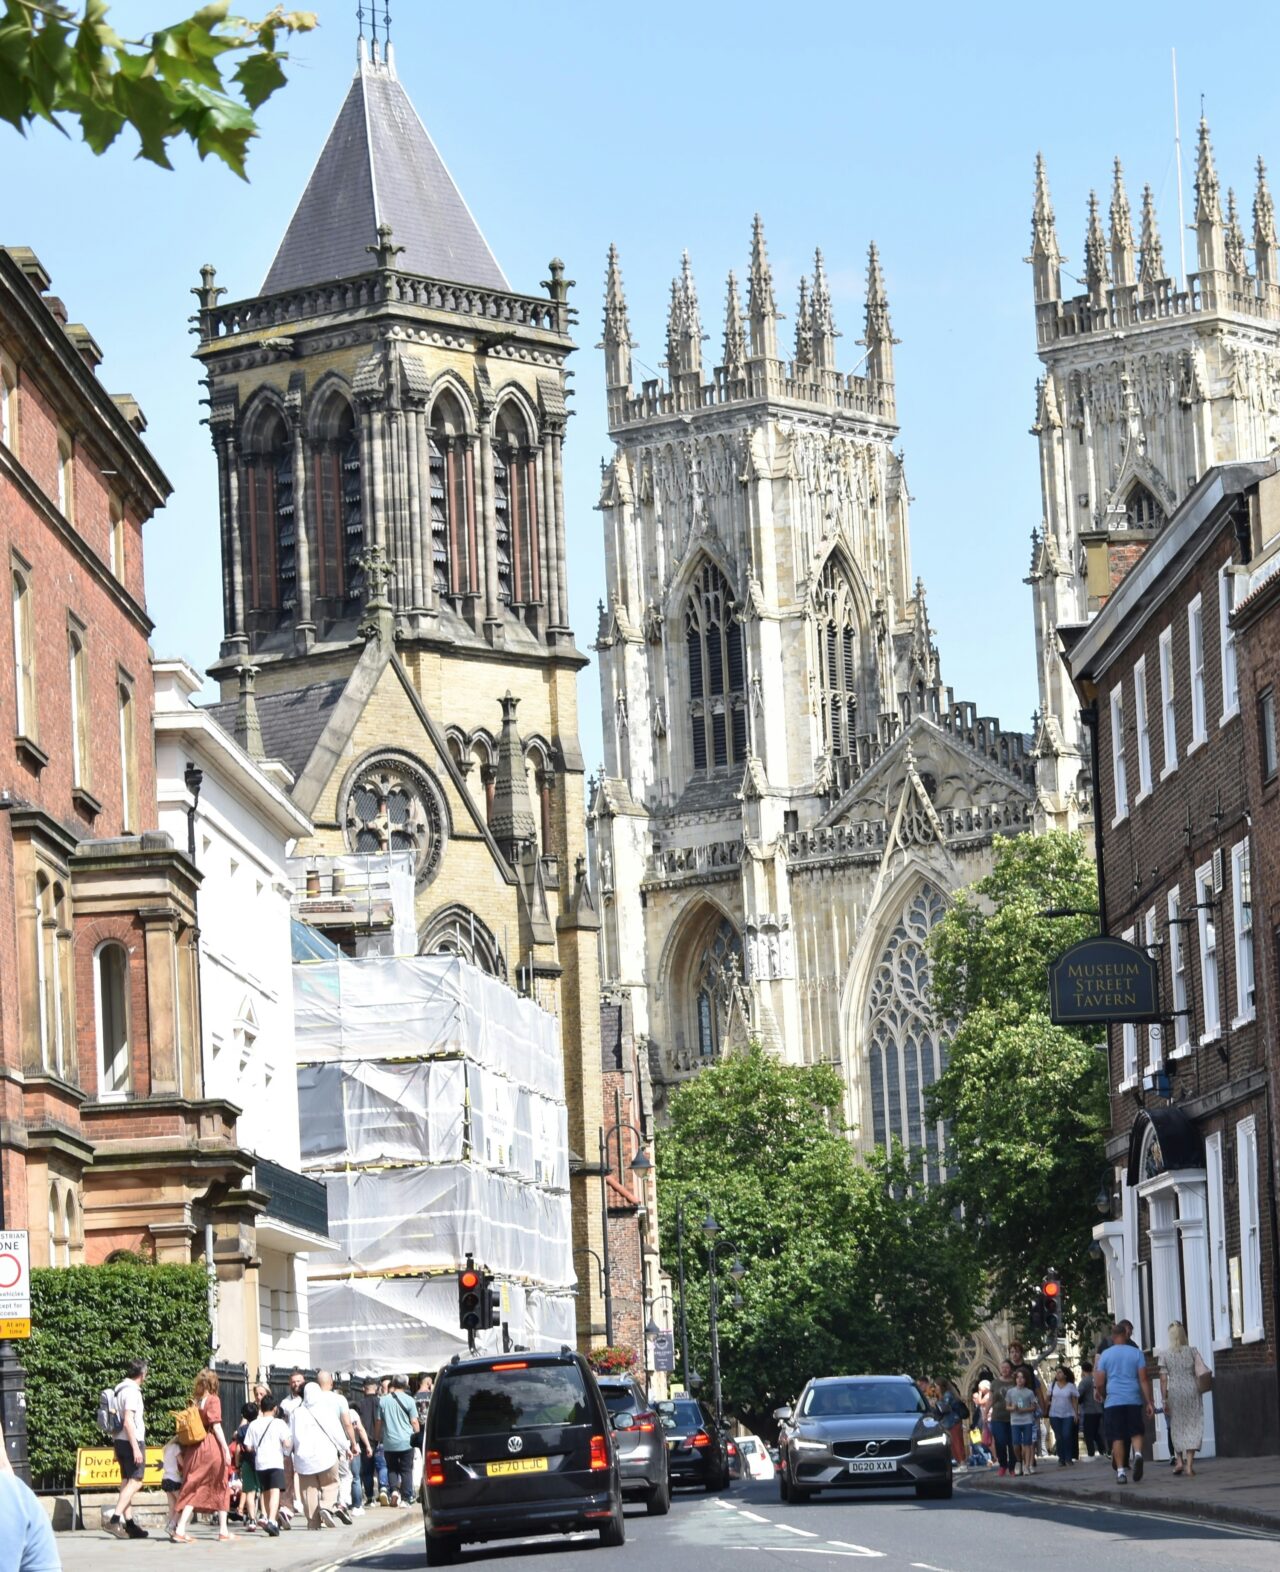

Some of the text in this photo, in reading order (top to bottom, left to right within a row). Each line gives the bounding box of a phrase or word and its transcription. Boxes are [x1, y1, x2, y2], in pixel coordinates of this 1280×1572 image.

[1068, 963, 1139, 977] MUSEUM
[1076, 977, 1132, 992] STREET
[1073, 993, 1136, 1007] TAVERN
[85, 1456, 119, 1467] Diver
[491, 1461, 519, 1473] GF70
[852, 1461, 893, 1472] DG20 XXA
[90, 1468, 120, 1479] traff
